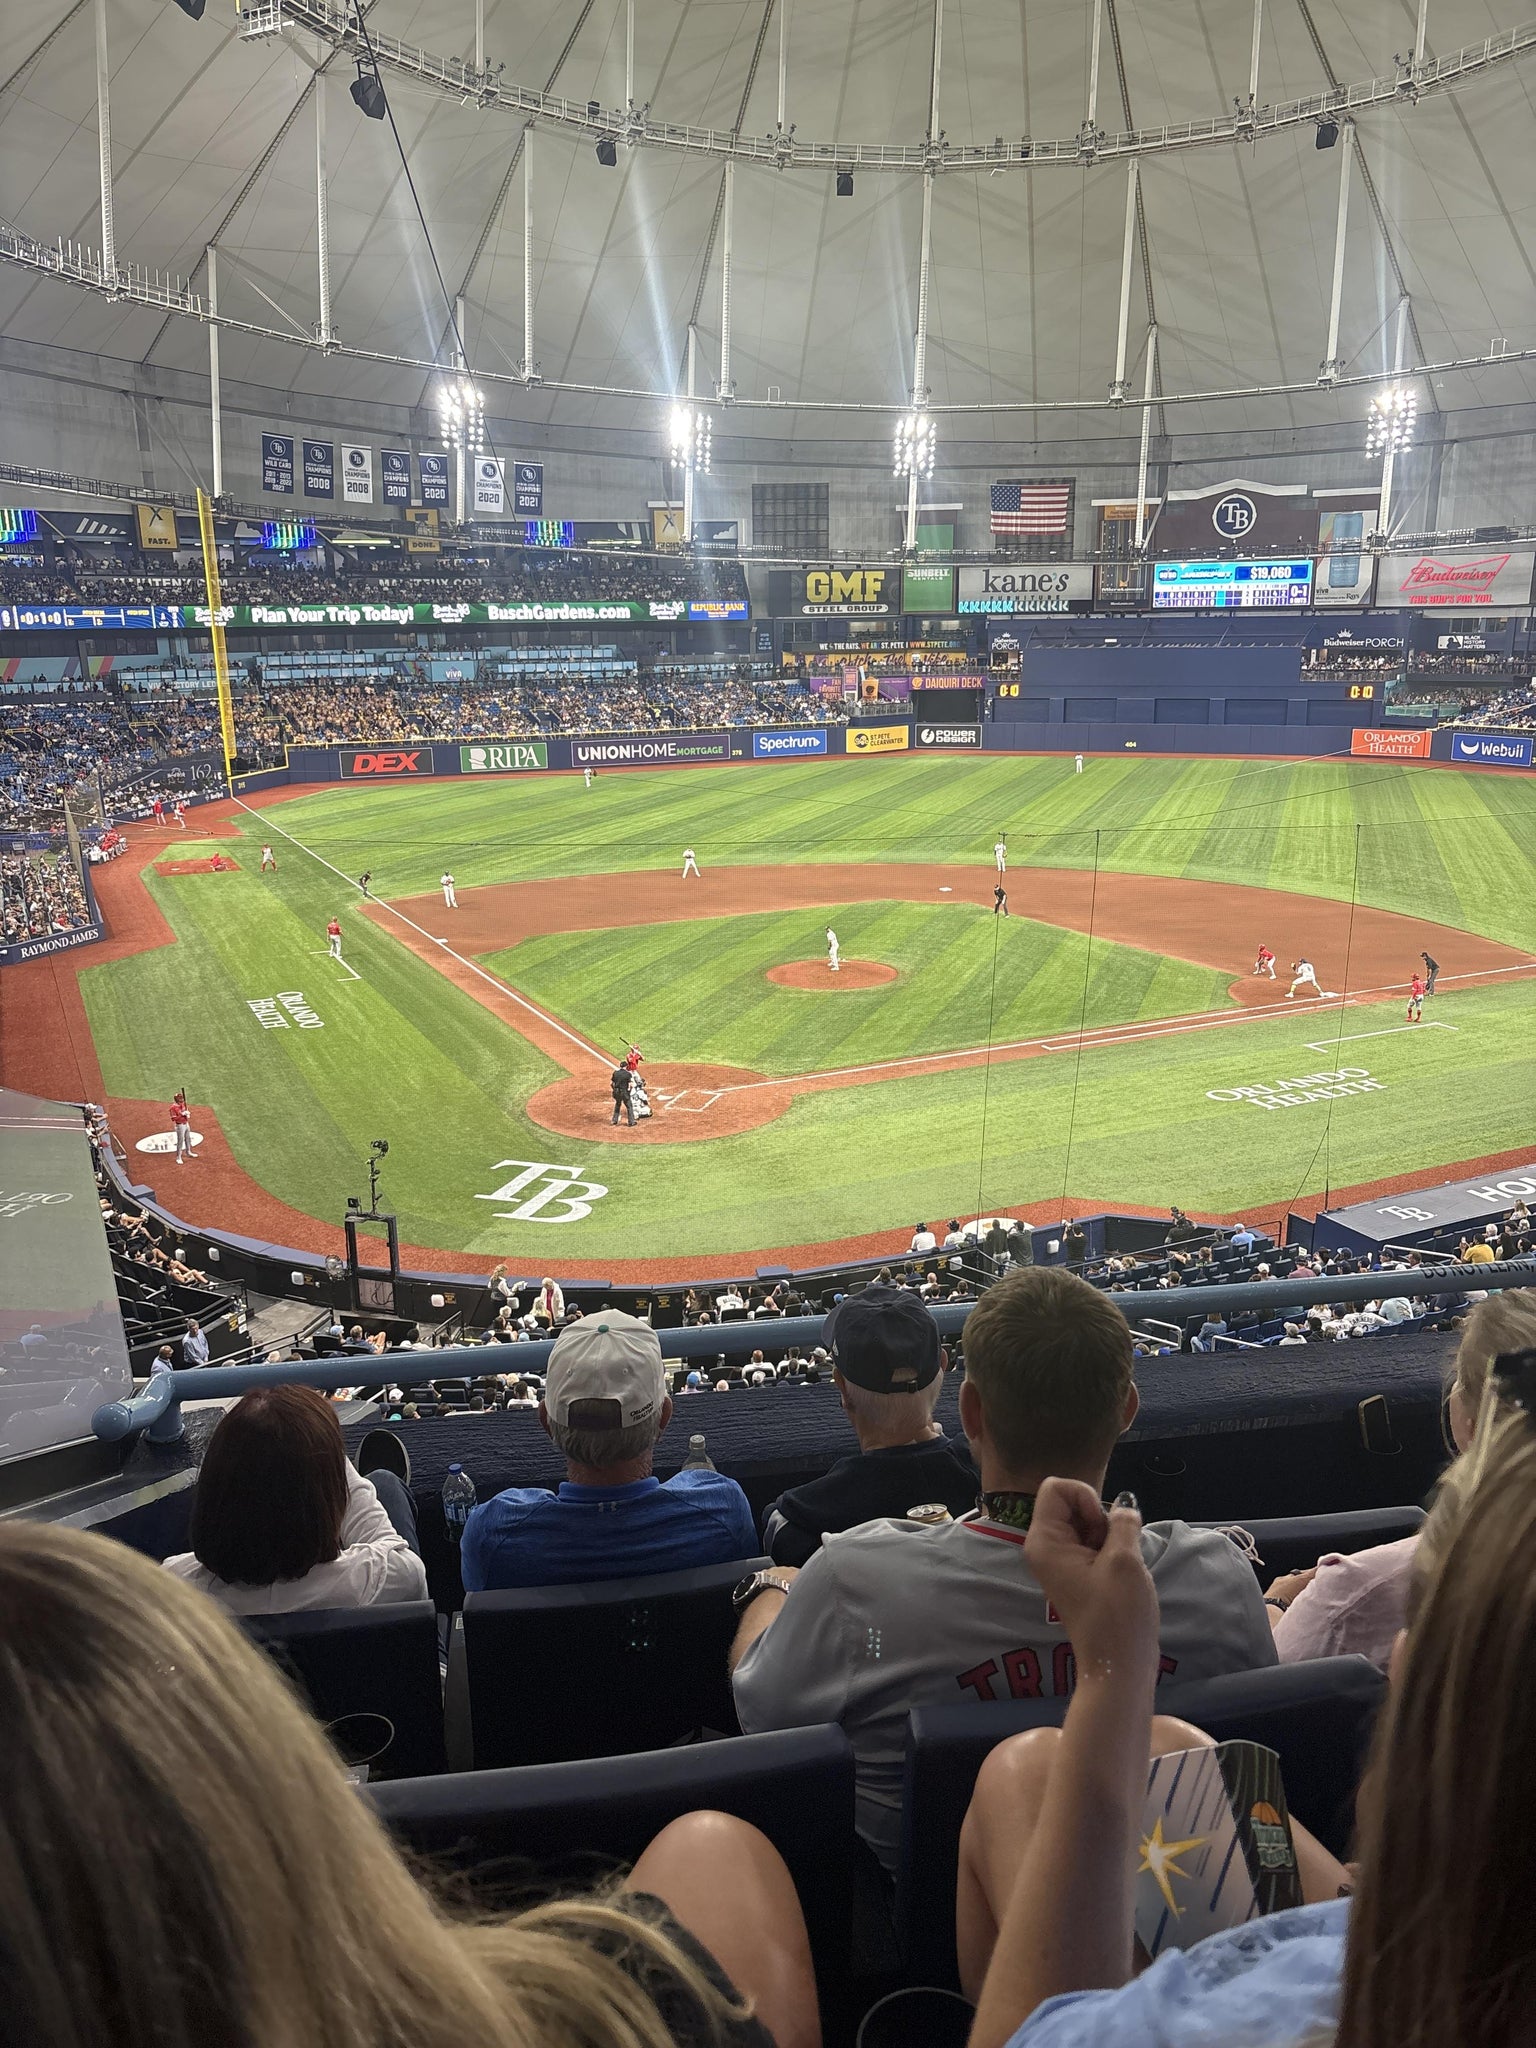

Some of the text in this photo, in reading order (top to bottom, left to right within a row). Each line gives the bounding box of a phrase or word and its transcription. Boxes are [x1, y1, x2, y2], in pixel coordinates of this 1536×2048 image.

[274, 442, 283, 453] TB
[314, 449, 323, 460] TB
[354, 454, 362, 464] TB
[278, 461, 292, 469] CARD
[393, 459, 400, 468] TB
[430, 462, 438, 471] TB
[305, 465, 332, 475] CHAMPIONS
[345, 470, 371, 479] CHAMPIONS
[486, 466, 494, 476] TB
[525, 470, 533, 479] TB
[308, 477, 330, 490] 2008
[384, 475, 409, 483] CHAMPIONS
[347, 481, 369, 494] 2008
[387, 486, 407, 498] 2010
[424, 488, 445, 499] 2020
[478, 492, 500, 503] 2020
[519, 496, 538, 507] 2021
[1221, 503, 1249, 530] TB
[907, 568, 950, 577] SUNBELT
[1251, 566, 1292, 580] $19,060
[1411, 566, 1498, 583] Budweiser
[806, 570, 885, 603] GMF
[982, 569, 1069, 593] kane's
[1409, 595, 1427, 604] THIS
[1456, 594, 1472, 603] FOR
[487, 603, 631, 620] BuschGardens.com
[690, 602, 745, 612] REPUBLIC BANK
[251, 607, 287, 623] Plan
[287, 607, 327, 623] Your
[326, 606, 360, 625] Trip
[362, 605, 414, 625] Today!
[991, 642, 1020, 650] PORCH
[1323, 638, 1404, 648] Budweiser PORCH
[925, 676, 983, 689] DAIQUIRI DECK
[870, 738, 903, 746] CLEARWATER
[1363, 731, 1421, 743] ORLANDO
[759, 736, 815, 753] Spectrum
[1369, 742, 1413, 754] HEALTH
[352, 751, 422, 774] DEX
[489, 745, 541, 769] RIPA
[190, 763, 212, 781] 162
[20, 928, 99, 958] RAYMOND JAMES
[245, 997, 291, 1029] HEALTH
[276, 991, 325, 1029] ORLANDO
[1205, 1067, 1370, 1102] ORLANDO
[1246, 1077, 1388, 1110] HEALTH
[473, 1159, 609, 1224] TB
[1376, 1205, 1435, 1222] TB
[1422, 1267, 1448, 1279] DO
[1451, 1263, 1482, 1276] NOT
[630, 1401, 654, 1417] ORLANDO
